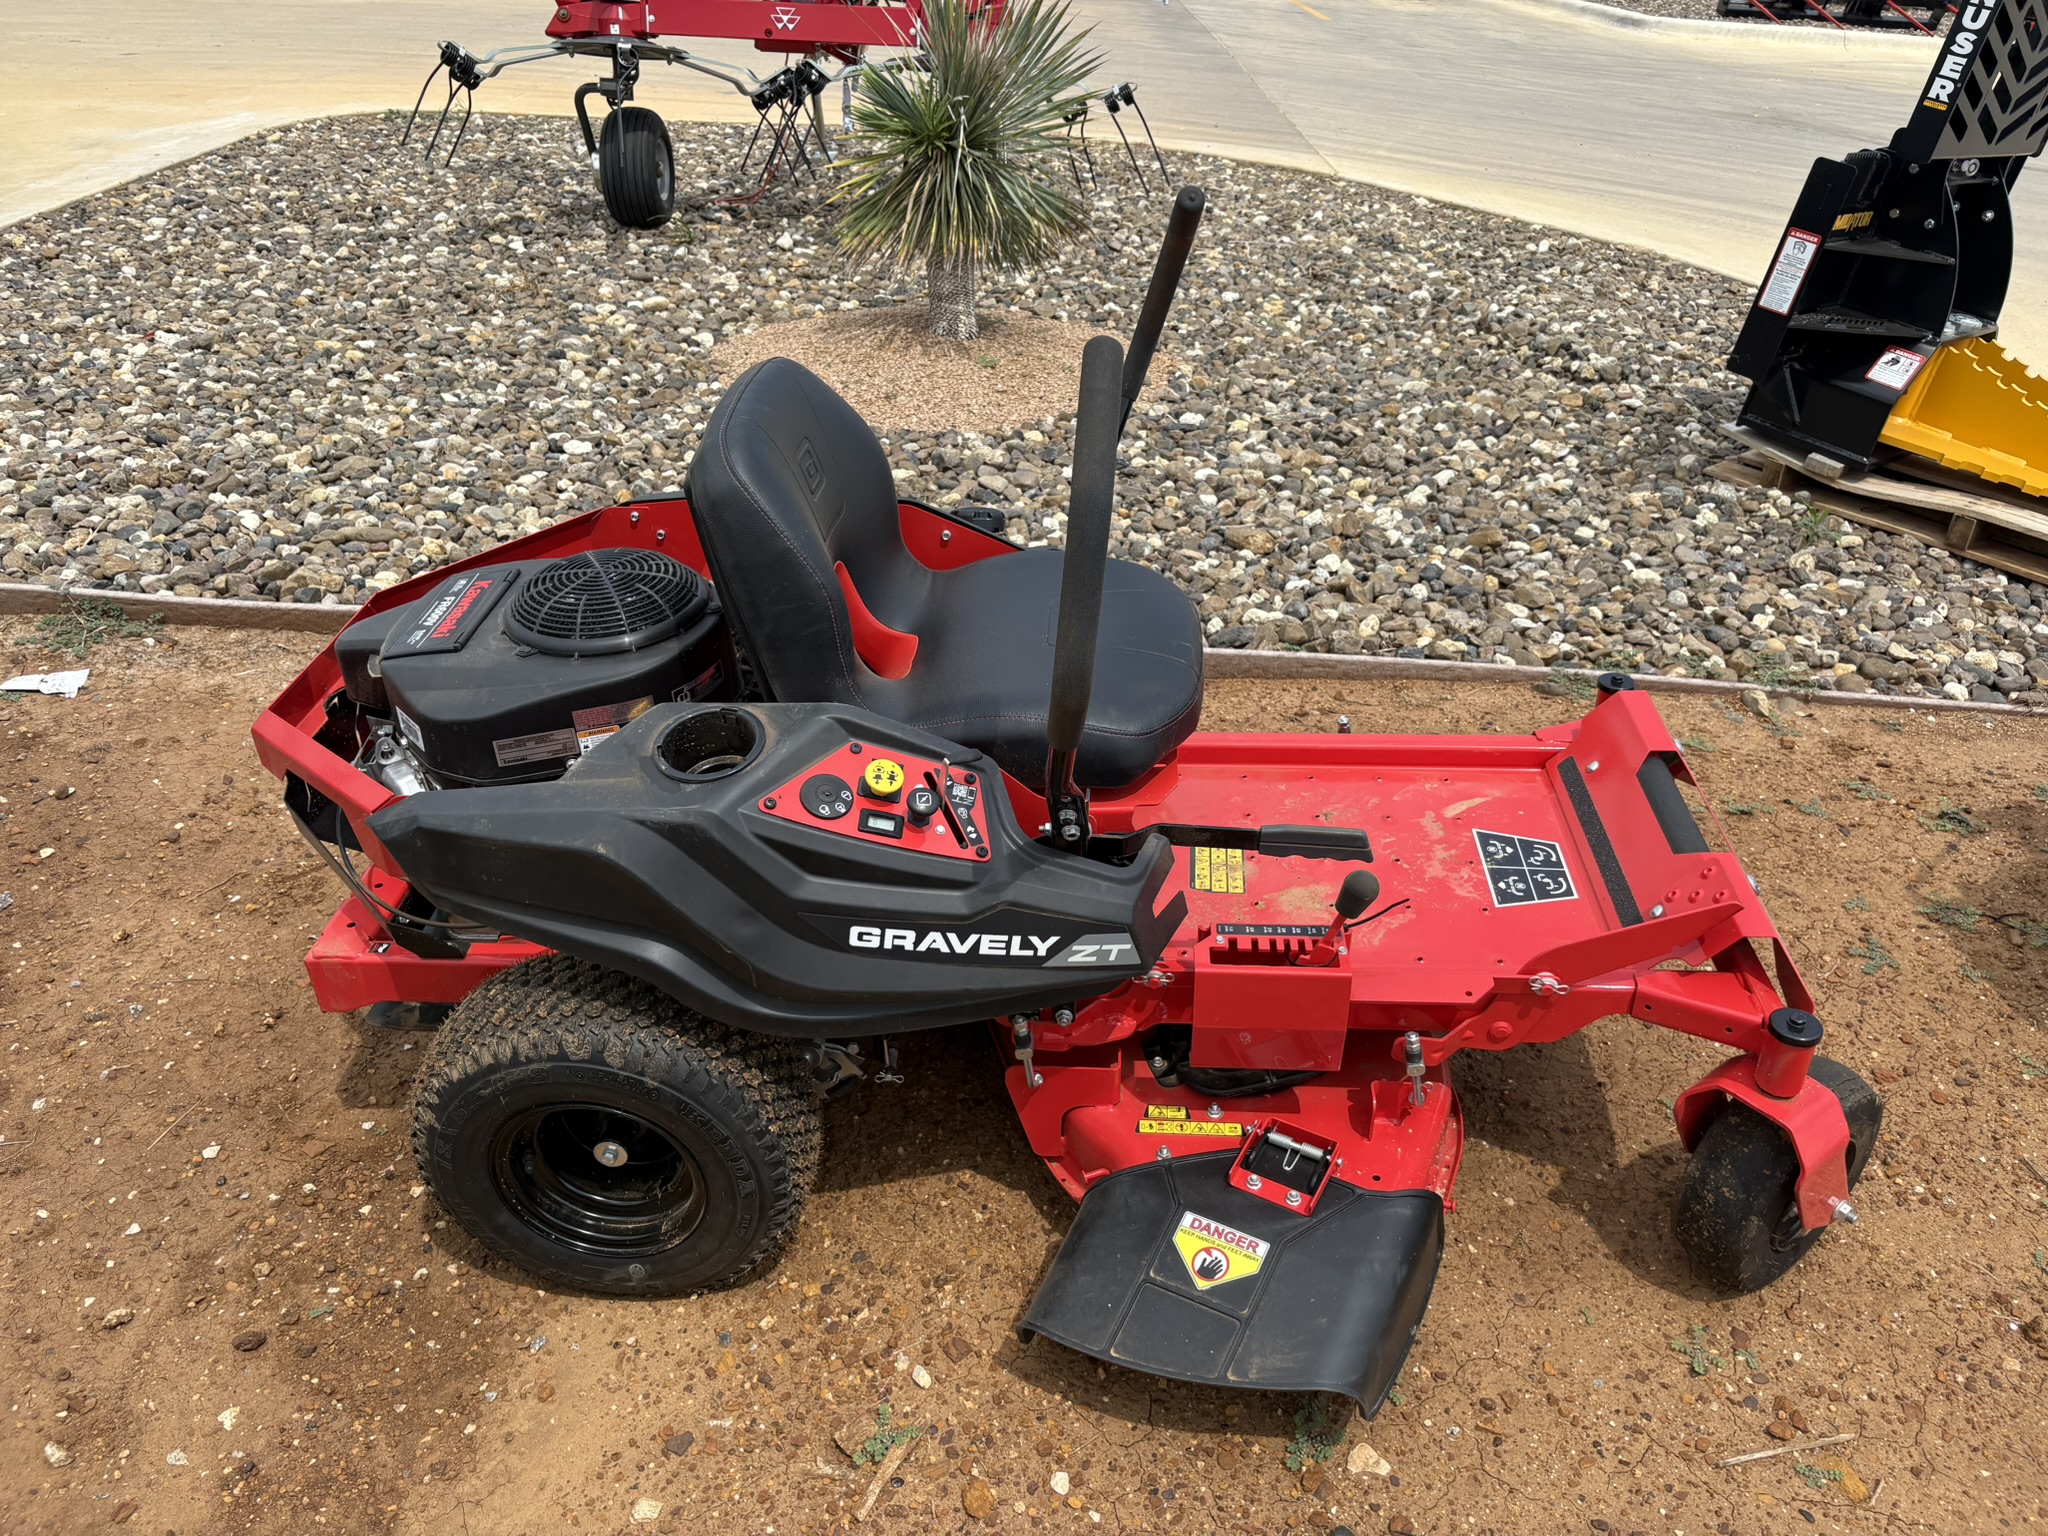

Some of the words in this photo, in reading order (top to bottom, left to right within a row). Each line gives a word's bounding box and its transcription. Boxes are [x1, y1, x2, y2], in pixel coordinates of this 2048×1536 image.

[1894, 349, 1922, 362] DANGER
[431, 579, 494, 639] Kawasaki
[588, 727, 615, 737] WARNING
[848, 925, 1061, 958] GRAVELY
[1066, 943, 1133, 963] ZT
[681, 1101, 757, 1200] KENDA
[1180, 1228, 1196, 1238] KEEP
[1196, 1234, 1217, 1246] HANDS
[1216, 1242, 1227, 1250] and
[1227, 1246, 1243, 1256] FEET
[1242, 1253, 1260, 1263] AWAY
[1189, 1217, 1260, 1254] DANGER
